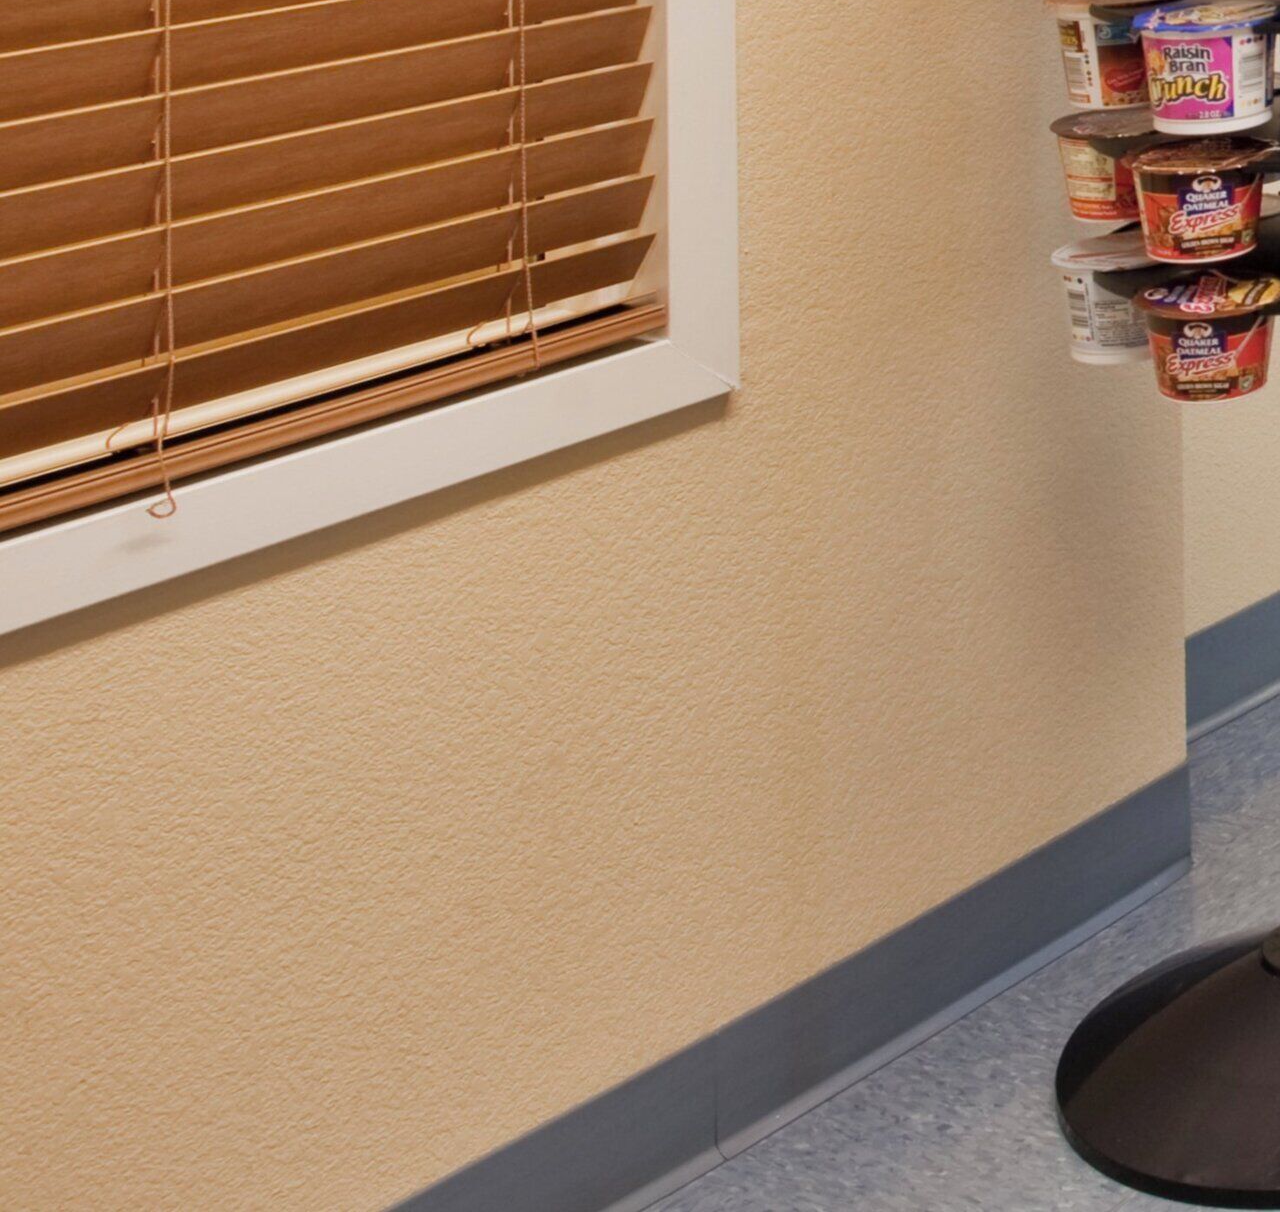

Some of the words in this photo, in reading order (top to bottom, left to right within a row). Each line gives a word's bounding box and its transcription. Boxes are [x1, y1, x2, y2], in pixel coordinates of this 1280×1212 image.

[1163, 46, 1211, 61] Raisin
[1169, 59, 1207, 73] Bran
[1186, 191, 1227, 202] QUAKER
[1168, 205, 1241, 234] Express
[1166, 352, 1235, 375] Express
